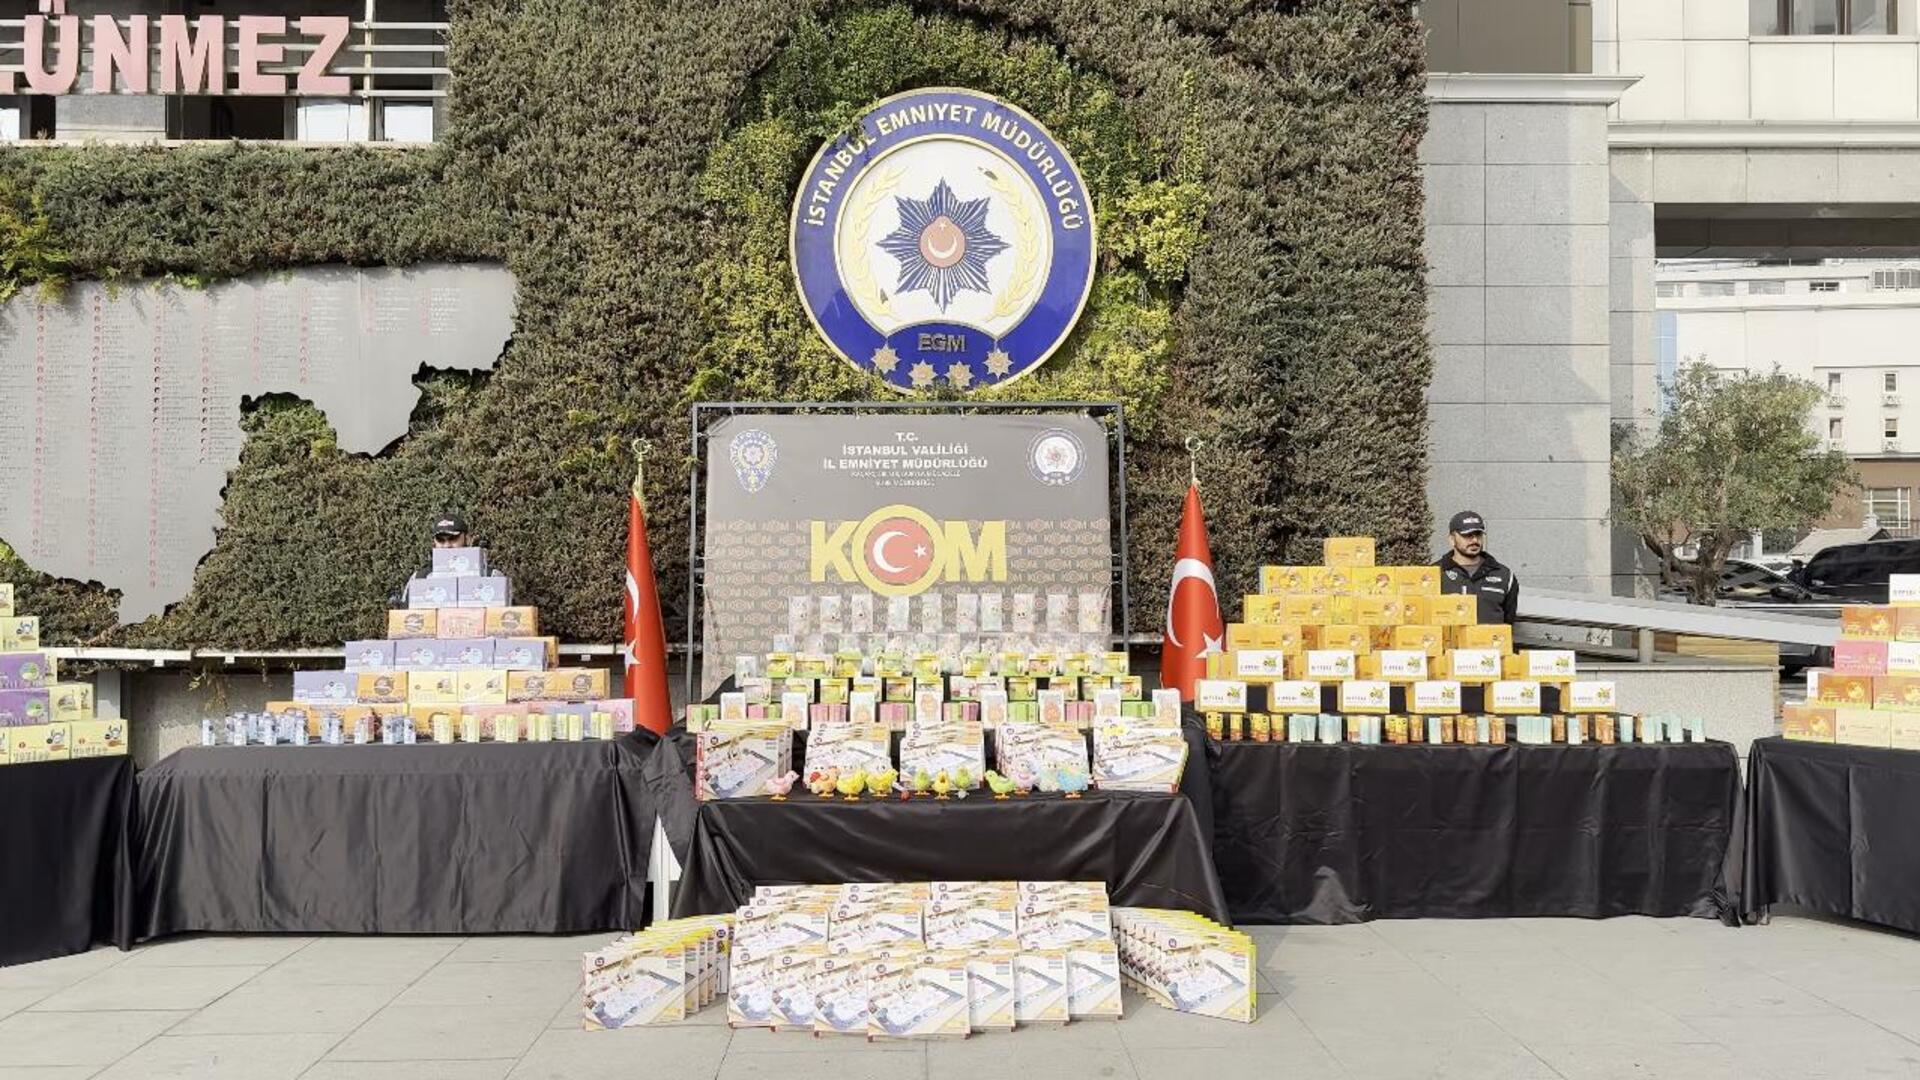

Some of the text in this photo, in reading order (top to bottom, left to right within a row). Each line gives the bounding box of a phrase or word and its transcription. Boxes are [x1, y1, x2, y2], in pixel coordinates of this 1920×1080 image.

[0, 0, 350, 95] ÜNMEZ
[980, 112, 1084, 230] MÜDÜRLÜĞÜ
[917, 333, 966, 352] EGM
[895, 432, 919, 442] T.C.
[843, 443, 968, 455] İSTANBUL VALİLİĞİ
[823, 456, 988, 469] İL EMNİYET MÜDÜRLÜĞÜ
[810, 504, 1008, 597] KOM
